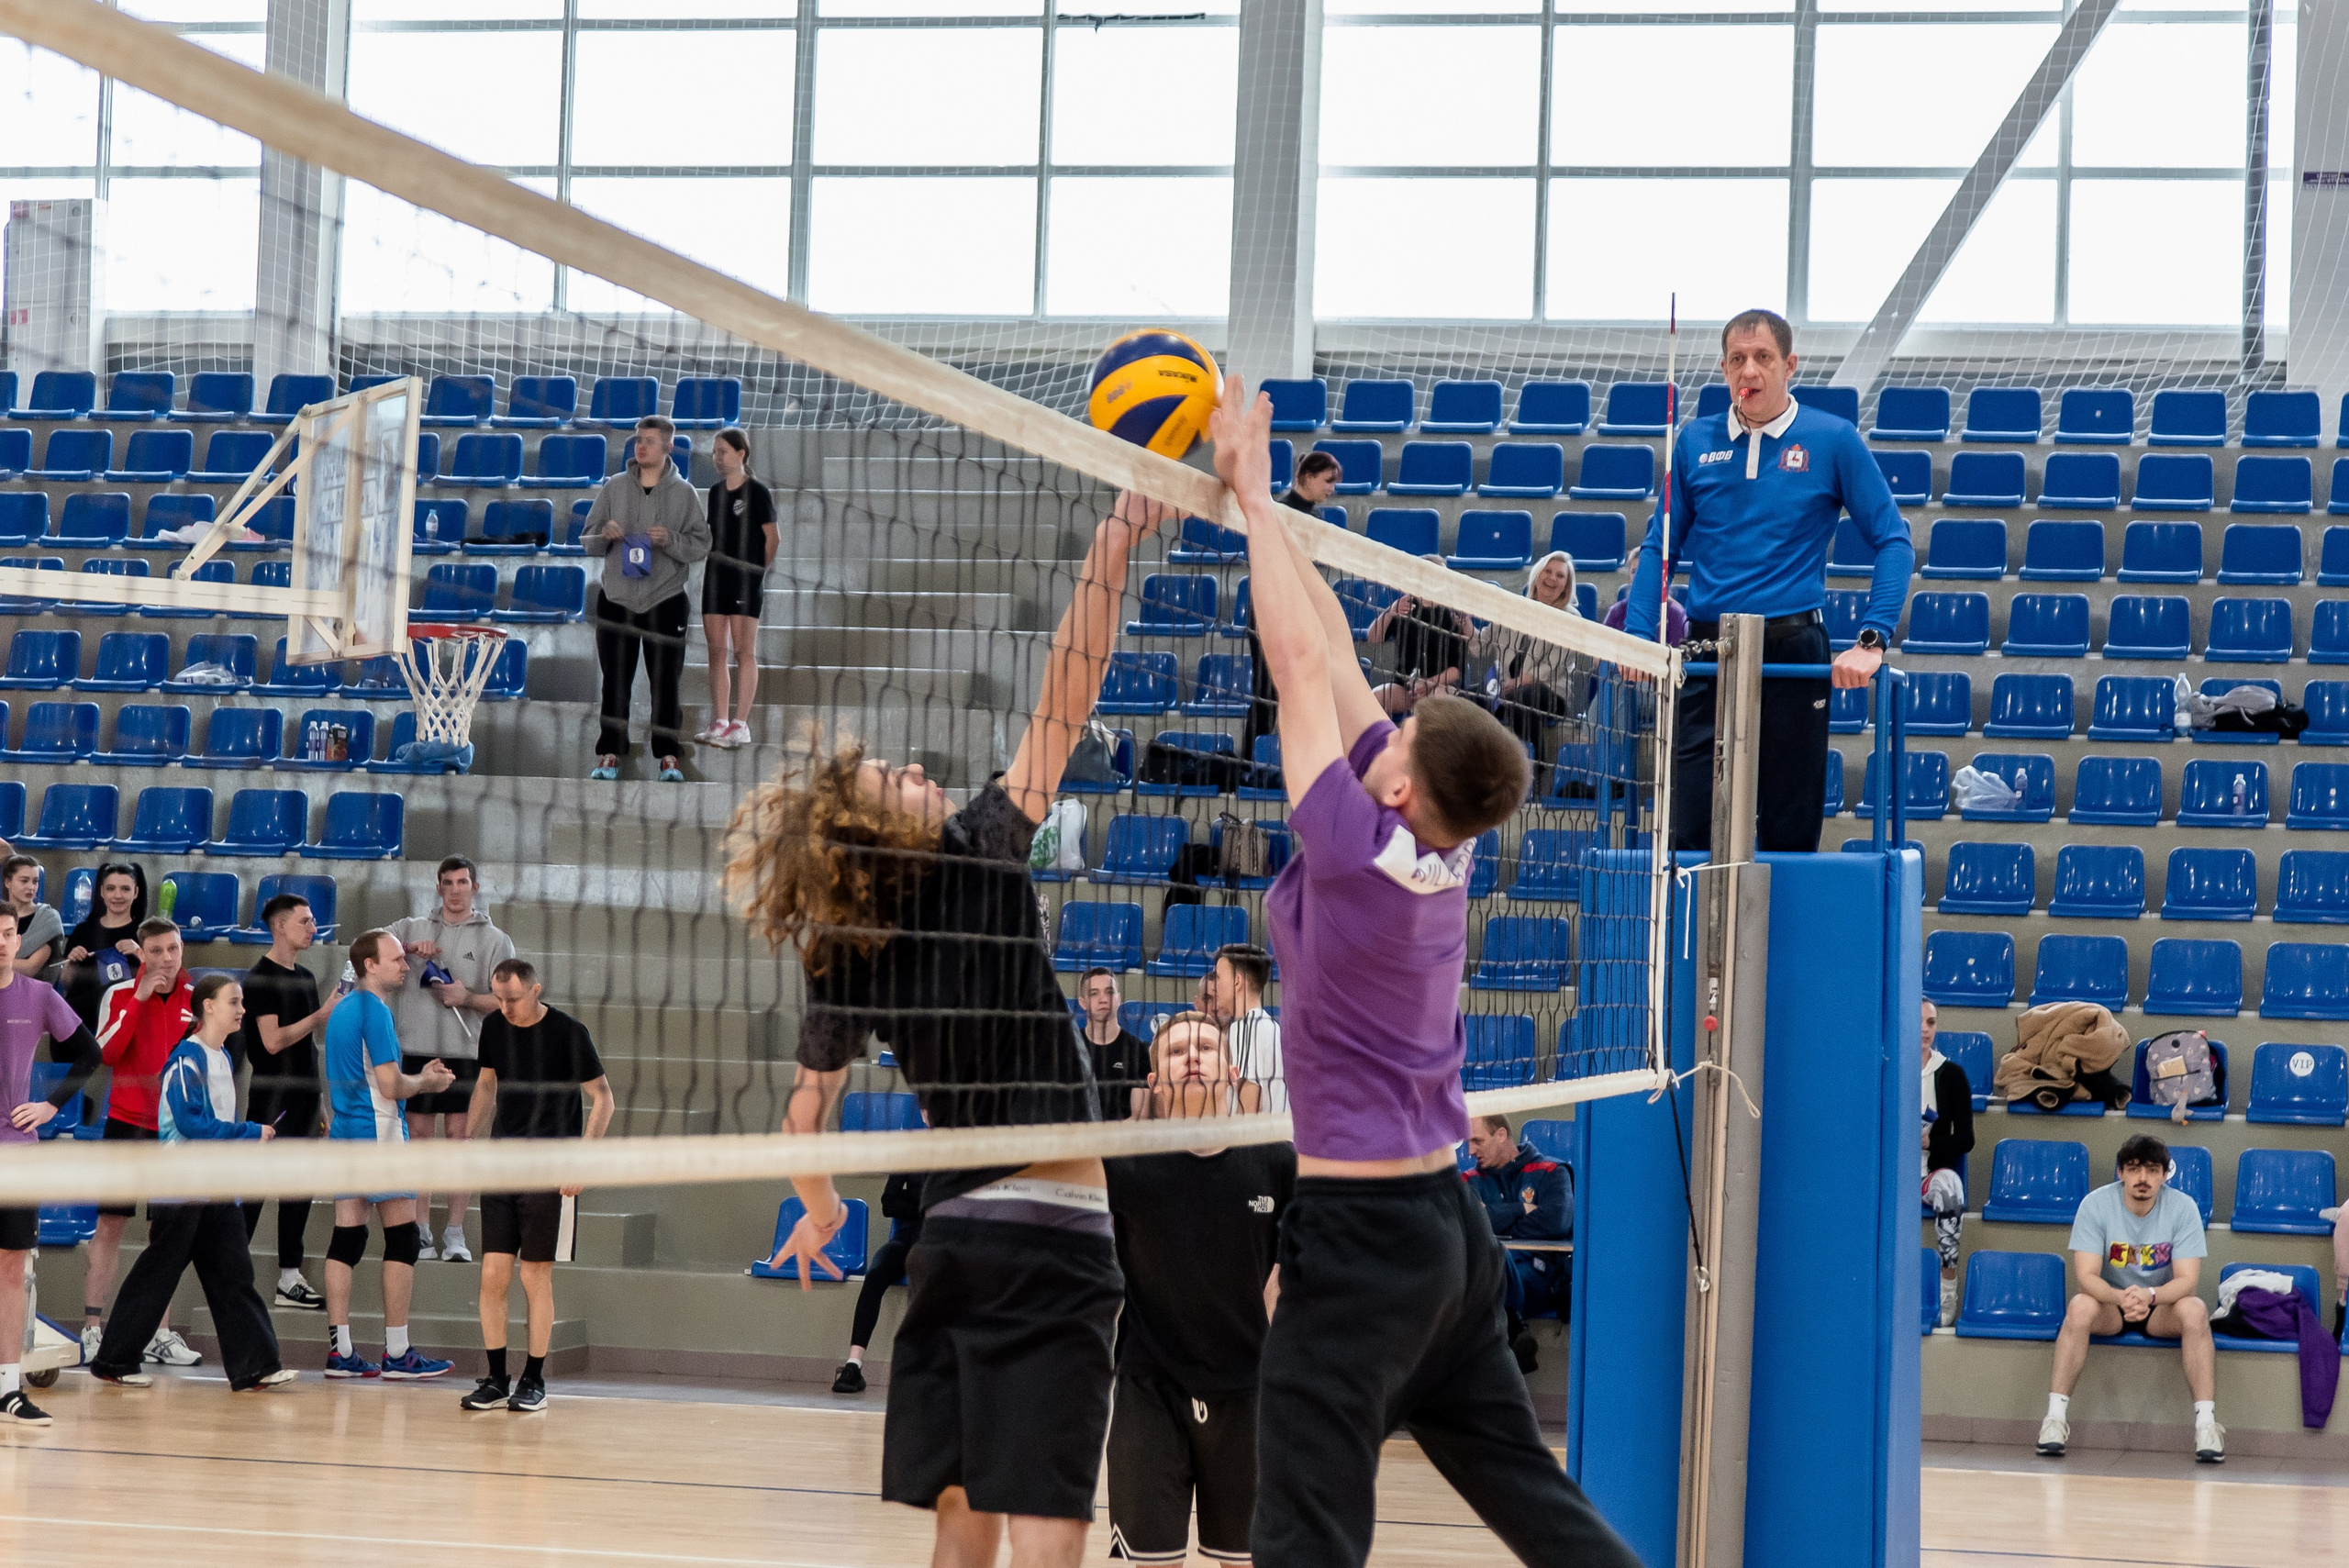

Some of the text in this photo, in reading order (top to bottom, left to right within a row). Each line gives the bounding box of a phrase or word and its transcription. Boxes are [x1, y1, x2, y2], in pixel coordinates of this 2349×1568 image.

[1708, 450, 1733, 462] ВФВ
[2292, 1059, 2313, 1069] VIP
[1055, 1187, 1086, 1199] Calvin
